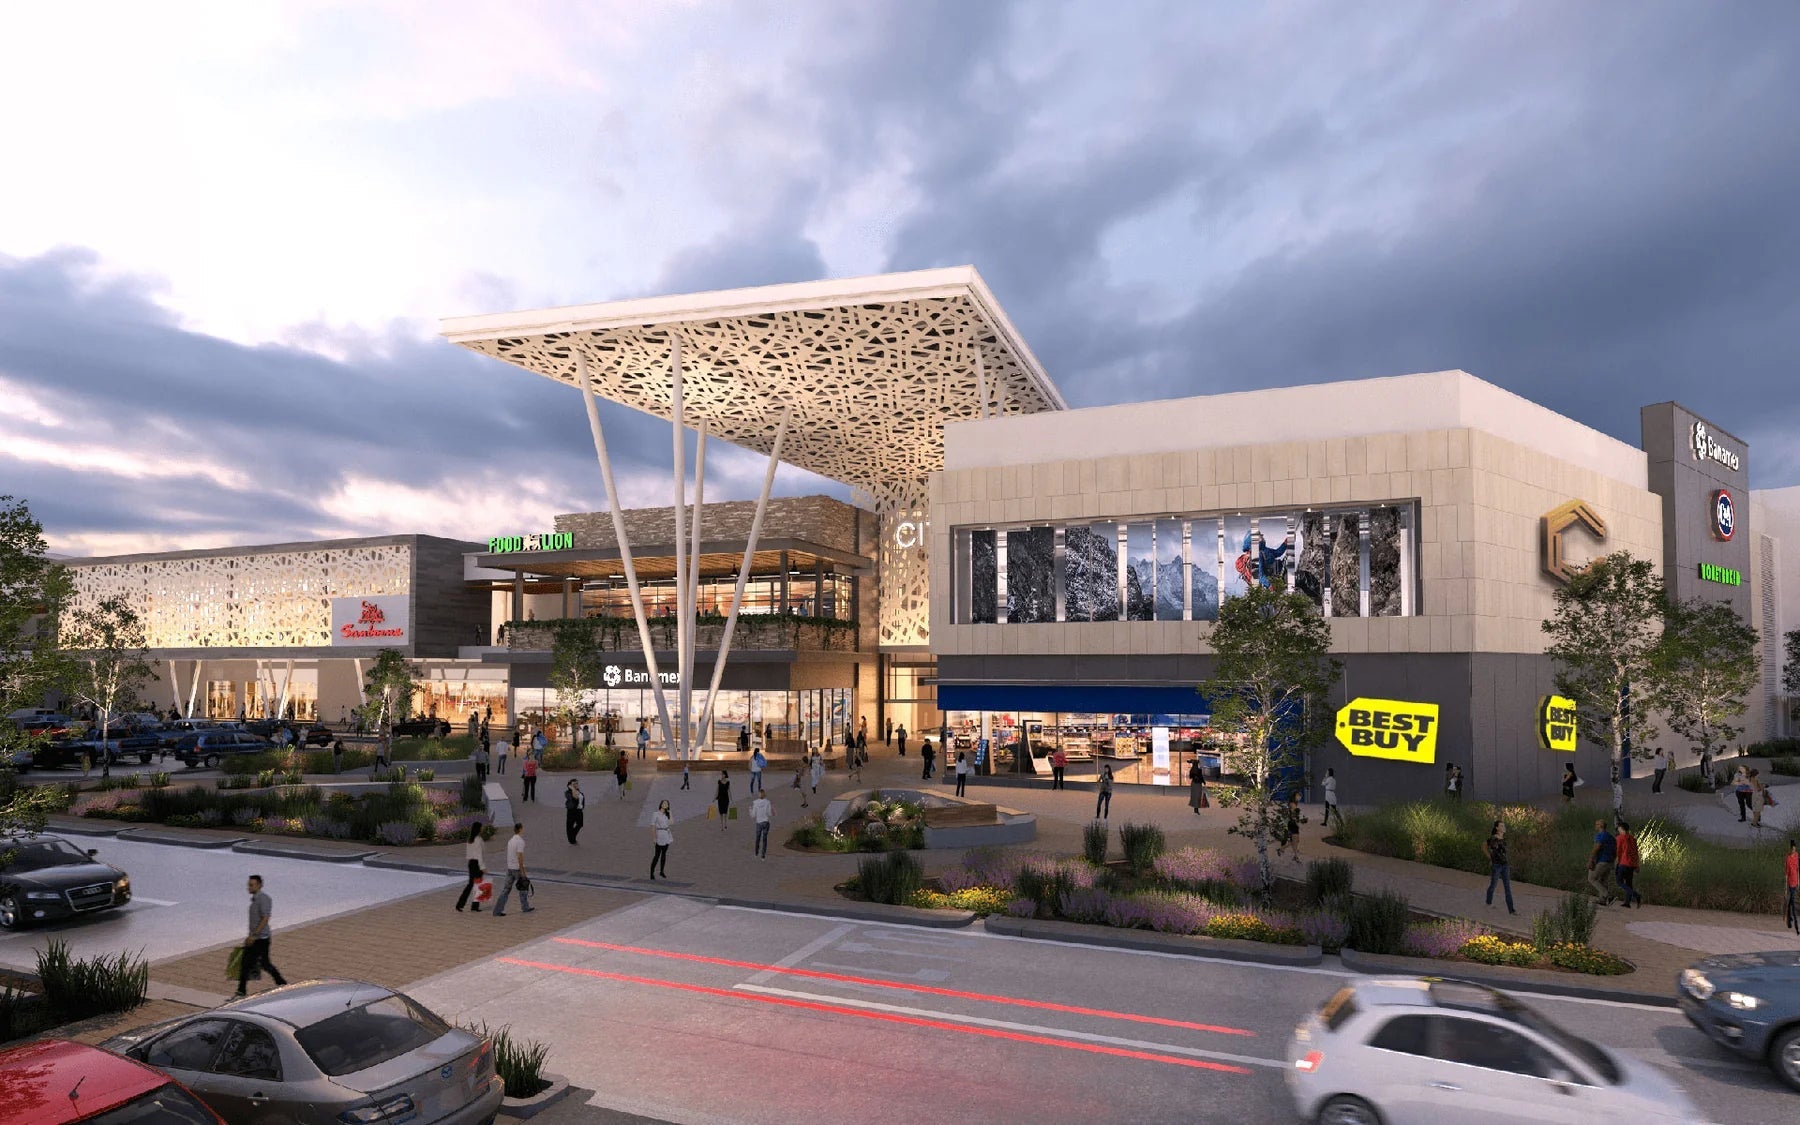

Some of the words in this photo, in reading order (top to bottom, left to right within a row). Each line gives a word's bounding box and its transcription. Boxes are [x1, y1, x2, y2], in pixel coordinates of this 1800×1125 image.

[488, 536, 523, 553] FOOD
[541, 531, 574, 551] LION
[896, 522, 930, 548] CI
[624, 668, 681, 684] Banme
[1348, 708, 1435, 733] BEST
[1351, 728, 1427, 752] BUY
[1550, 724, 1574, 742] BUY
